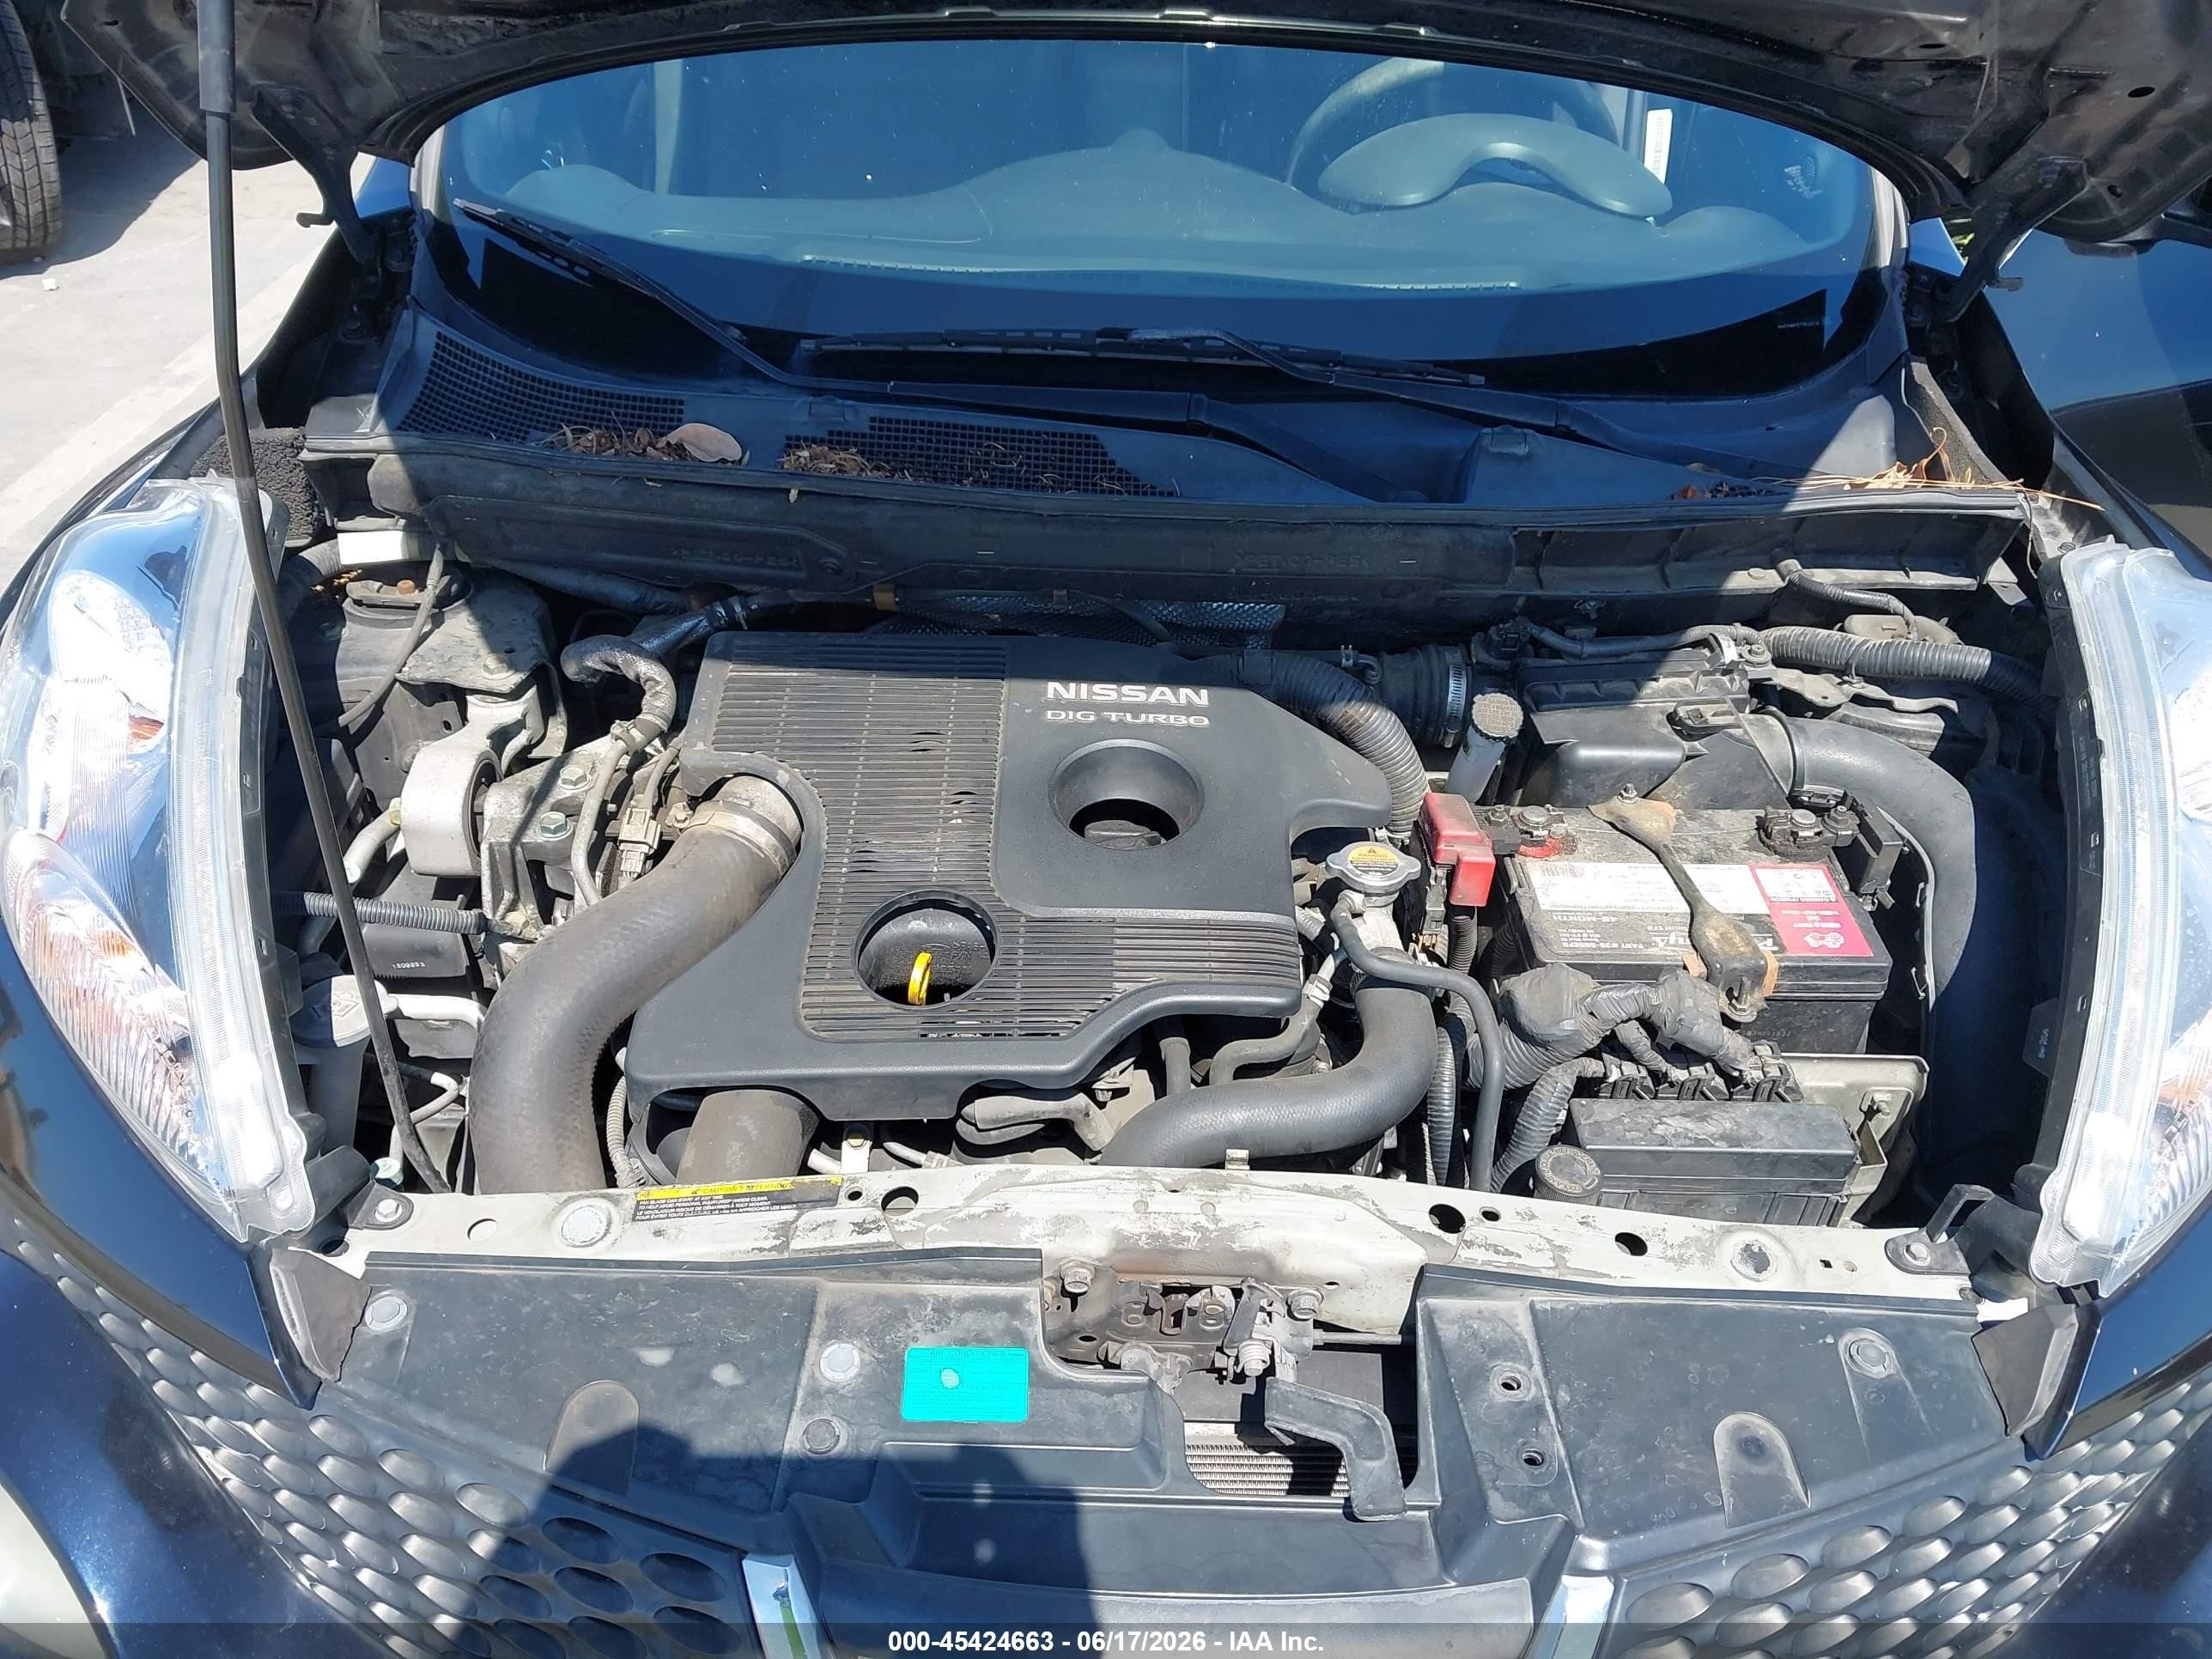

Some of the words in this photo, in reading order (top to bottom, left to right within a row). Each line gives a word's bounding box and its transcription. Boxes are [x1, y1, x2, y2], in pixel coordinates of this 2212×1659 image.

[1047, 682, 1209, 707] NISSAN
[1046, 709, 1095, 721] DIG
[1104, 711, 1210, 727] TURBO
